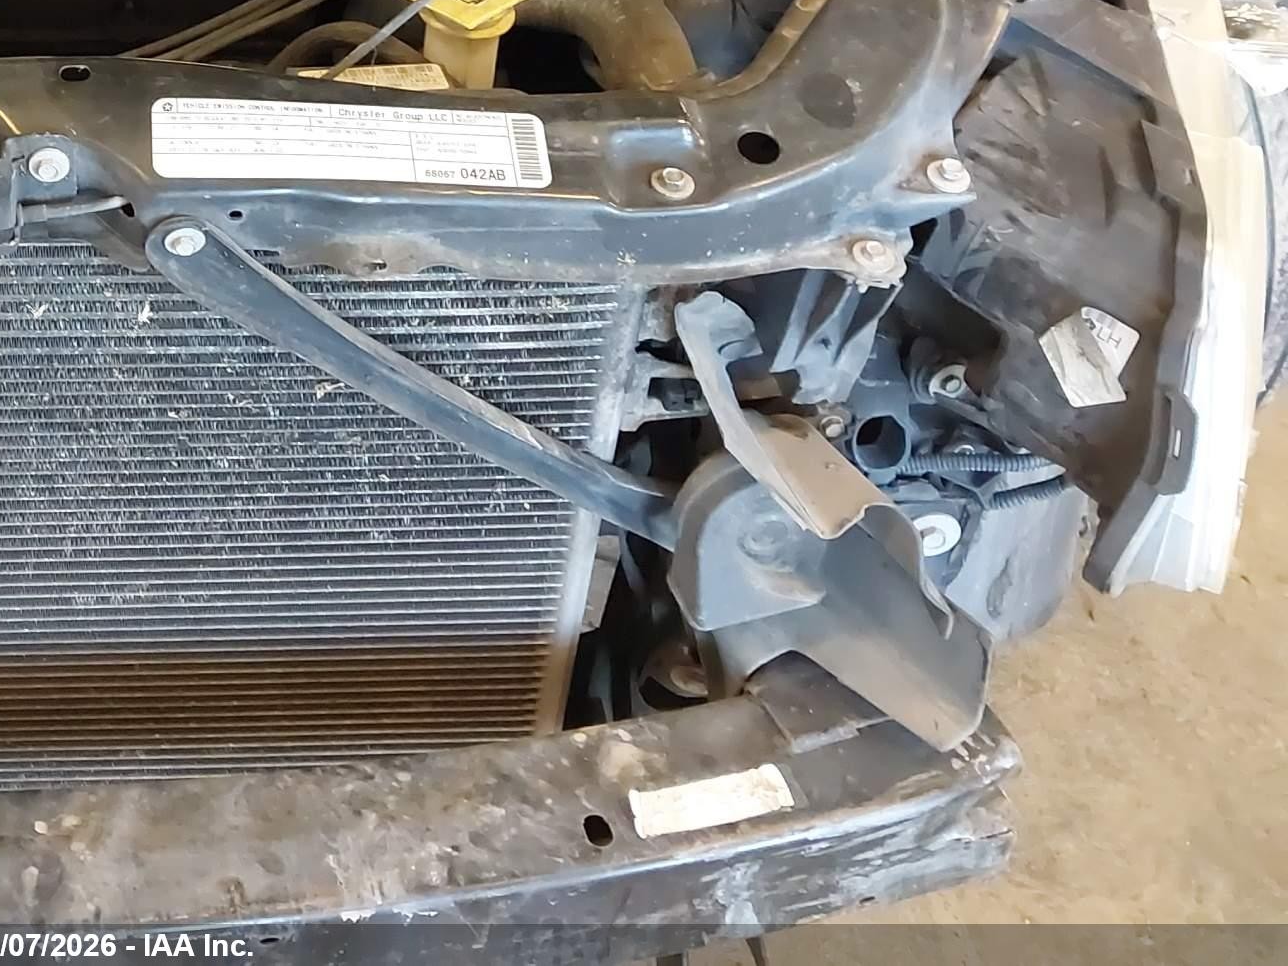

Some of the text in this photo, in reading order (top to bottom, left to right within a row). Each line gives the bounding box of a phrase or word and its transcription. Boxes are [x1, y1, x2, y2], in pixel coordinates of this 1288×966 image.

[338, 108, 385, 120] Chrysler
[393, 111, 424, 122] Group
[429, 113, 448, 122] LLC
[460, 168, 507, 181] 042AB
